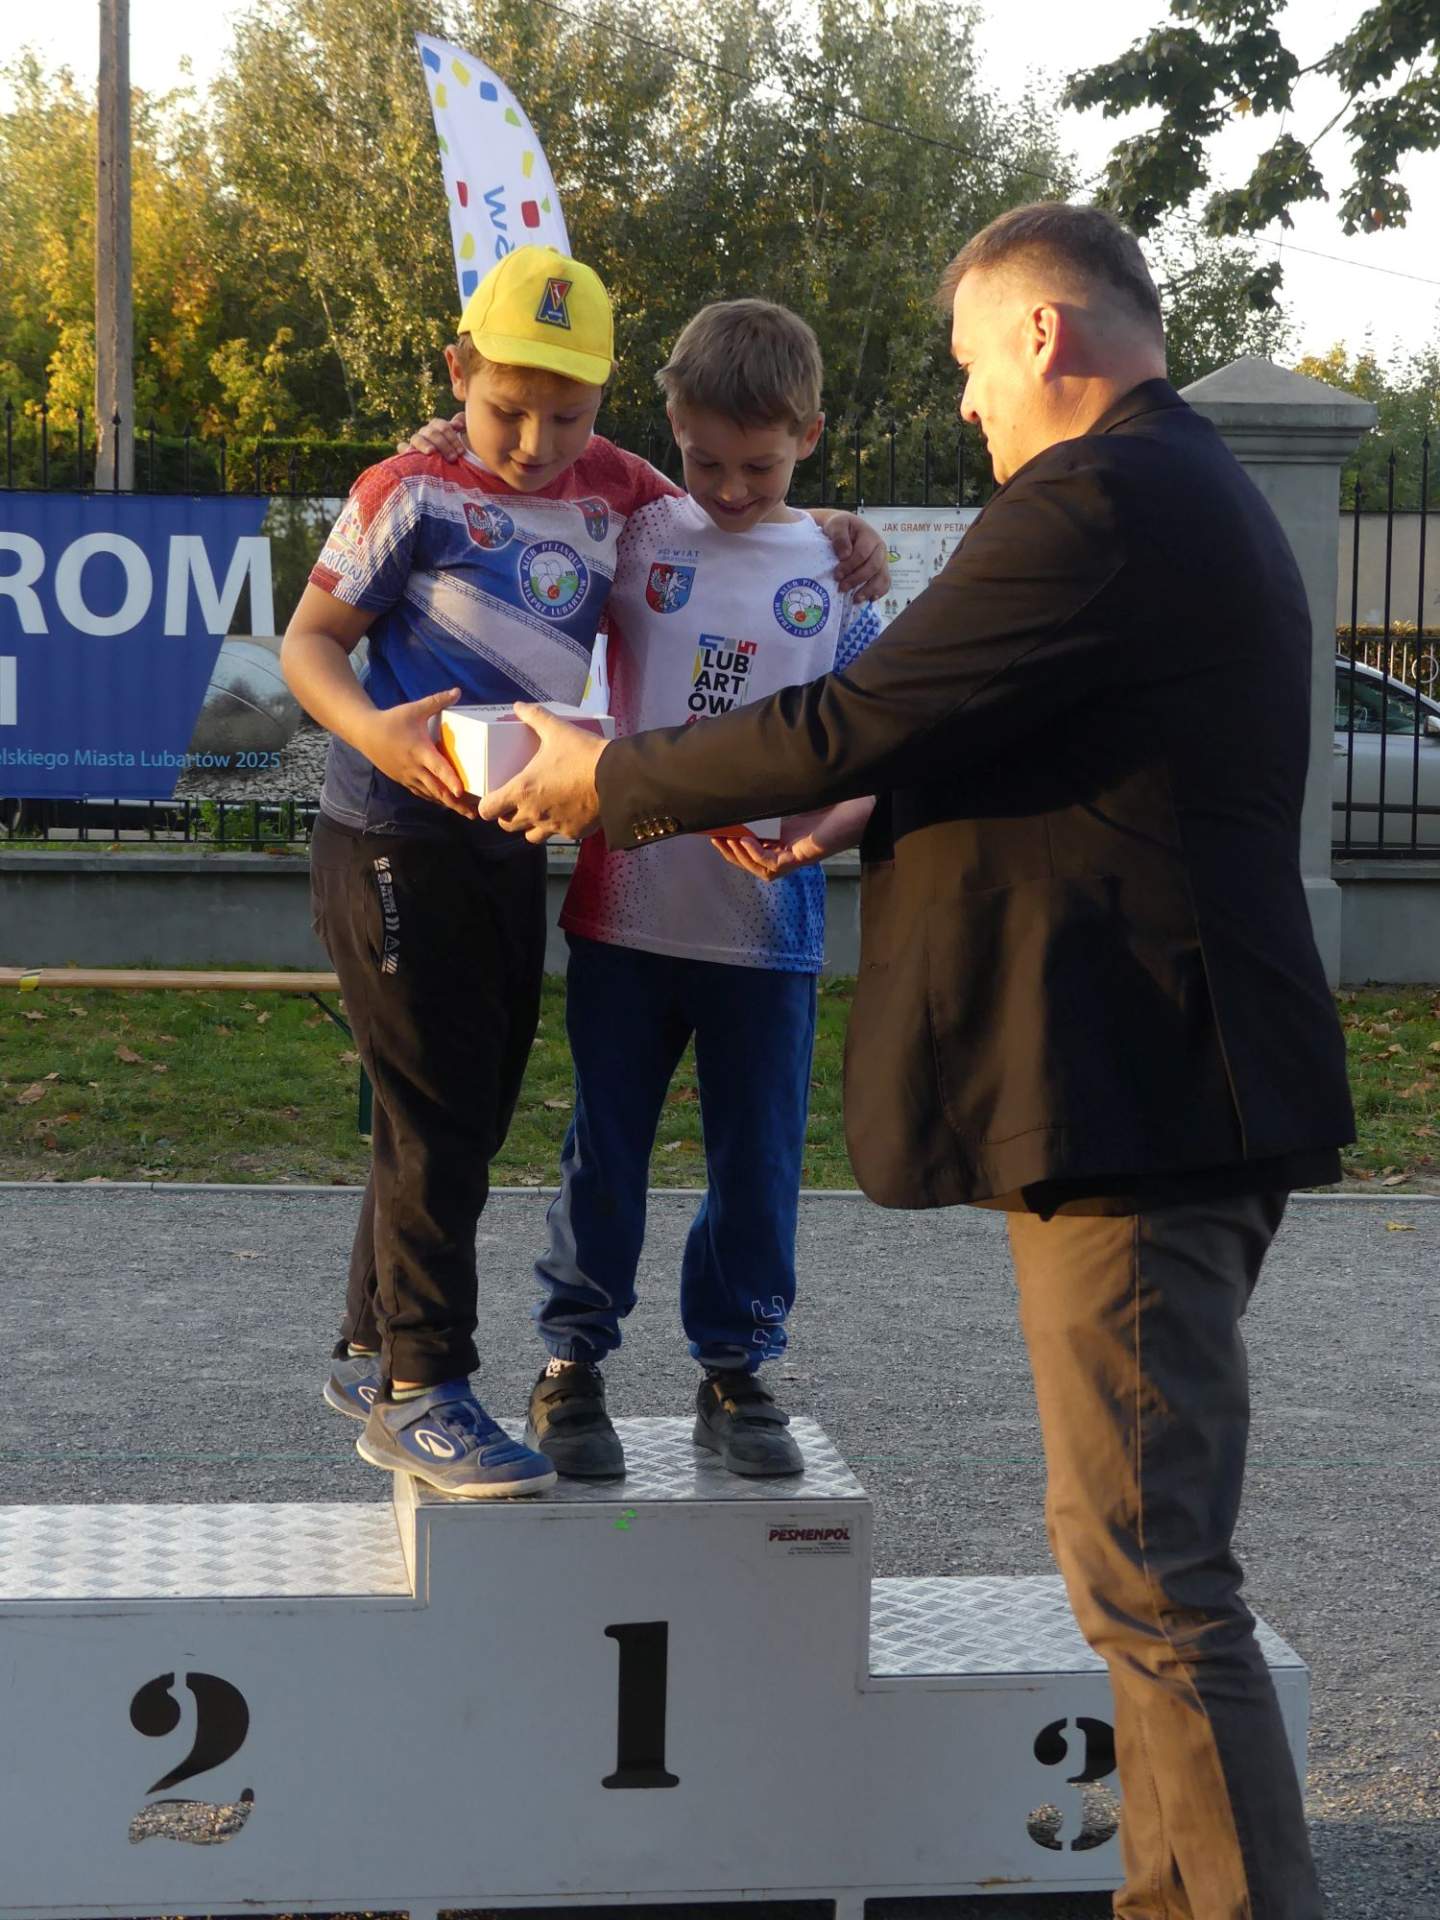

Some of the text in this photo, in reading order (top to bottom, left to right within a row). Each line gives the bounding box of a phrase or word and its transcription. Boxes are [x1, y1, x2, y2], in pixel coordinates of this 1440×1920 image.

[882, 523, 898, 532] JAK
[900, 522, 930, 532] GRAMY
[933, 523, 942, 532] W
[703, 649, 750, 674] LUB
[694, 670, 745, 695] ART
[688, 687, 734, 714] ÓW
[0, 747, 281, 770] lskiego Miasta Lubartów 2025
[768, 1528, 851, 1541] PESMENPOL
[601, 1621, 681, 1788] 1
[129, 1671, 255, 1846] 2
[1027, 1716, 1119, 1851] 3
